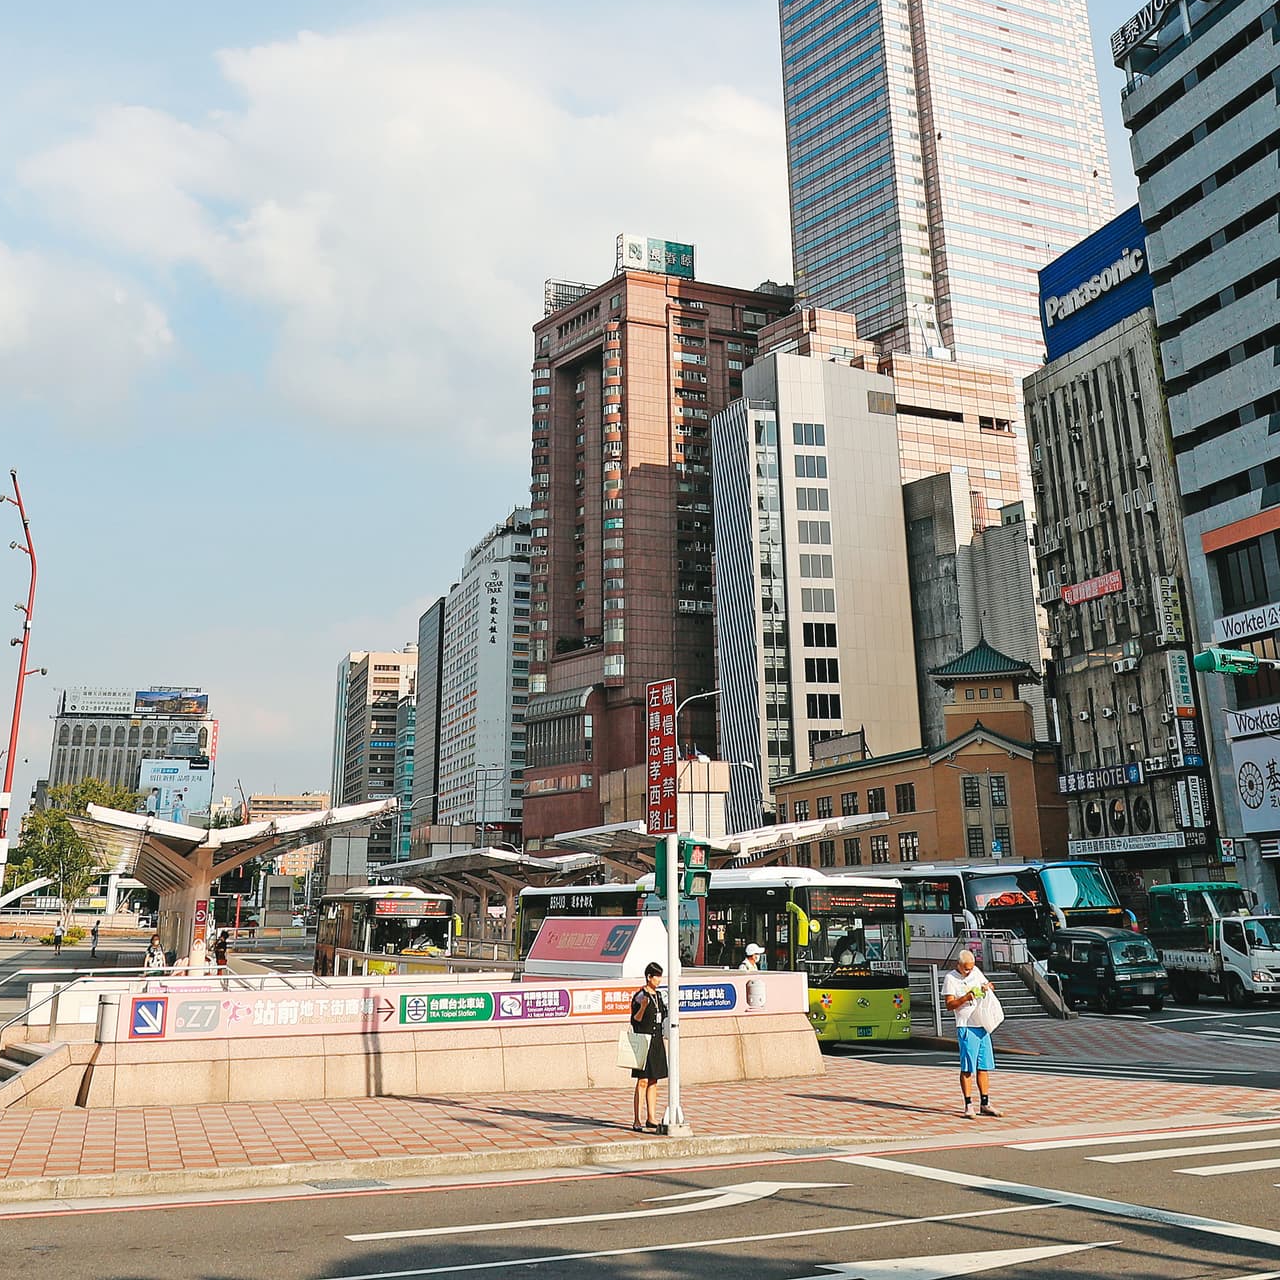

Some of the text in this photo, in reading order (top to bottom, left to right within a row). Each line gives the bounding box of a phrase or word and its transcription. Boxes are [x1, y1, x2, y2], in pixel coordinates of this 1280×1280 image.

[1044, 247, 1144, 328] Panasonic
[1160, 577, 1177, 636] Click Hotel
[648, 687, 662, 832] 左轉忠孝西路
[661, 684, 676, 831] 機慢車禁止
[1187, 756, 1198, 766] 3F
[186, 1005, 217, 1028] Z7
[441, 1010, 458, 1018] Taipei
[457, 1009, 477, 1017] Station
[714, 998, 732, 1007] Station
